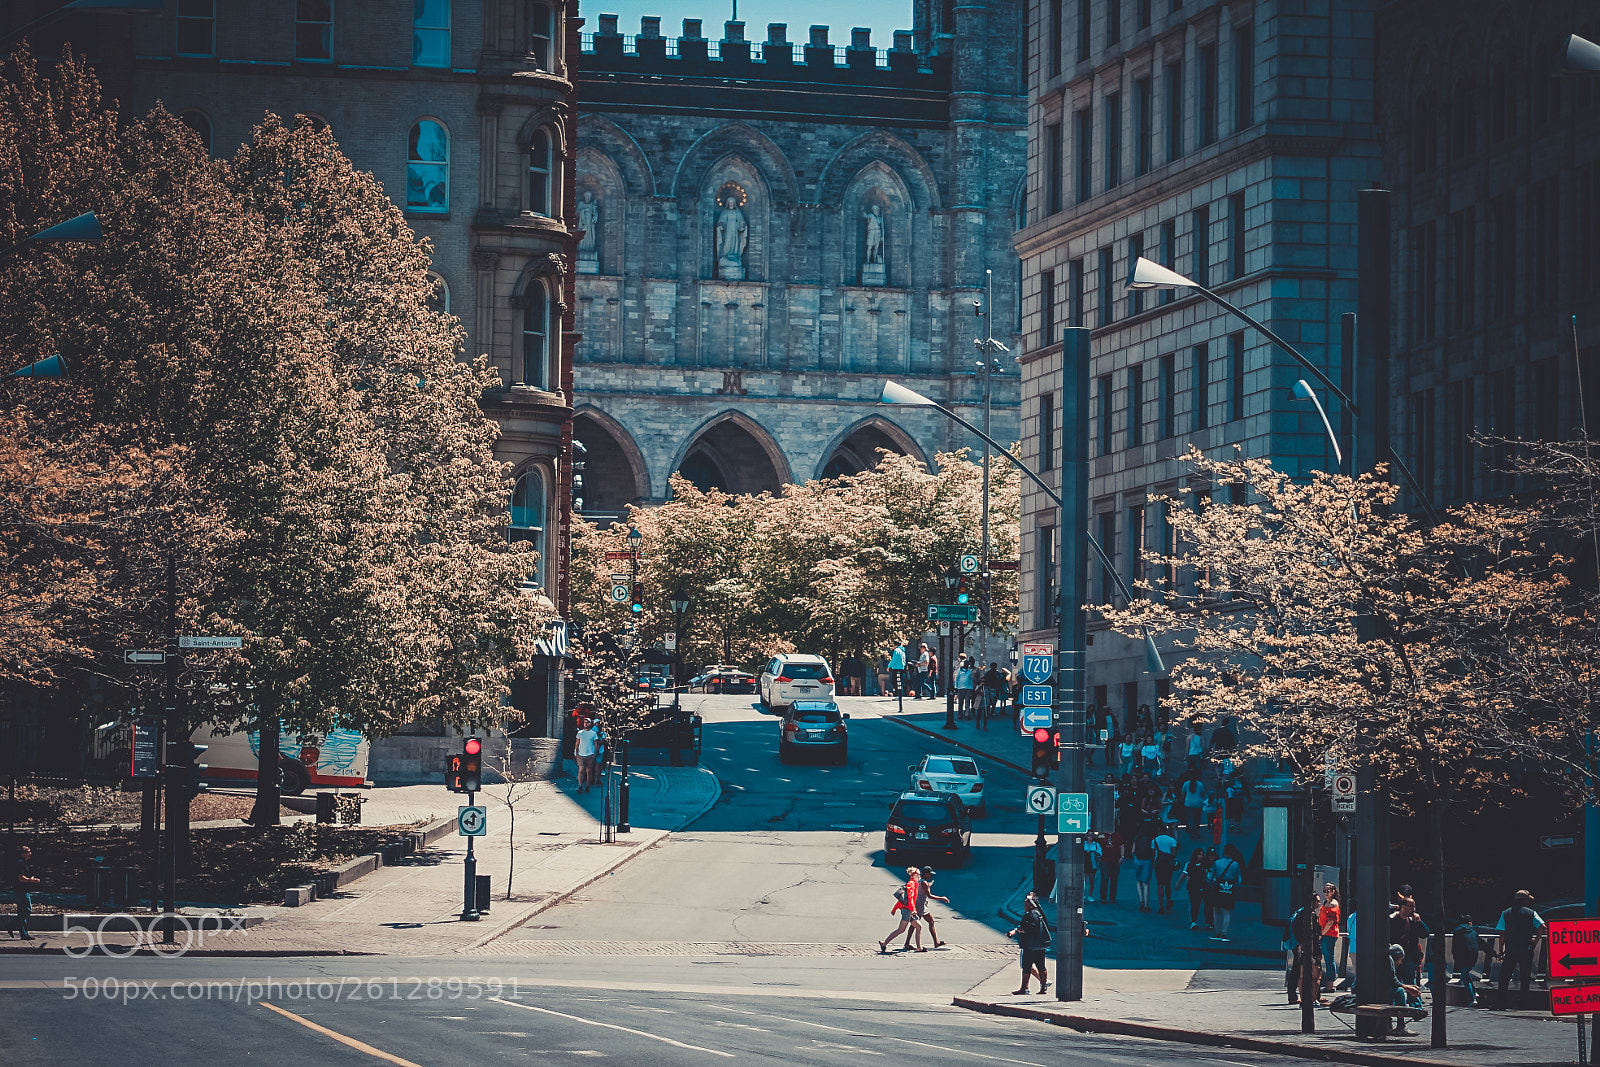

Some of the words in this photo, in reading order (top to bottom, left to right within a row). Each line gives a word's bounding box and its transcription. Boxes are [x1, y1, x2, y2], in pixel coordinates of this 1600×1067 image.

[1027, 657, 1049, 673] 720
[1027, 690, 1048, 701] EST
[1552, 928, 1600, 944] DÉTOUR
[1553, 995, 1572, 1005] RUE
